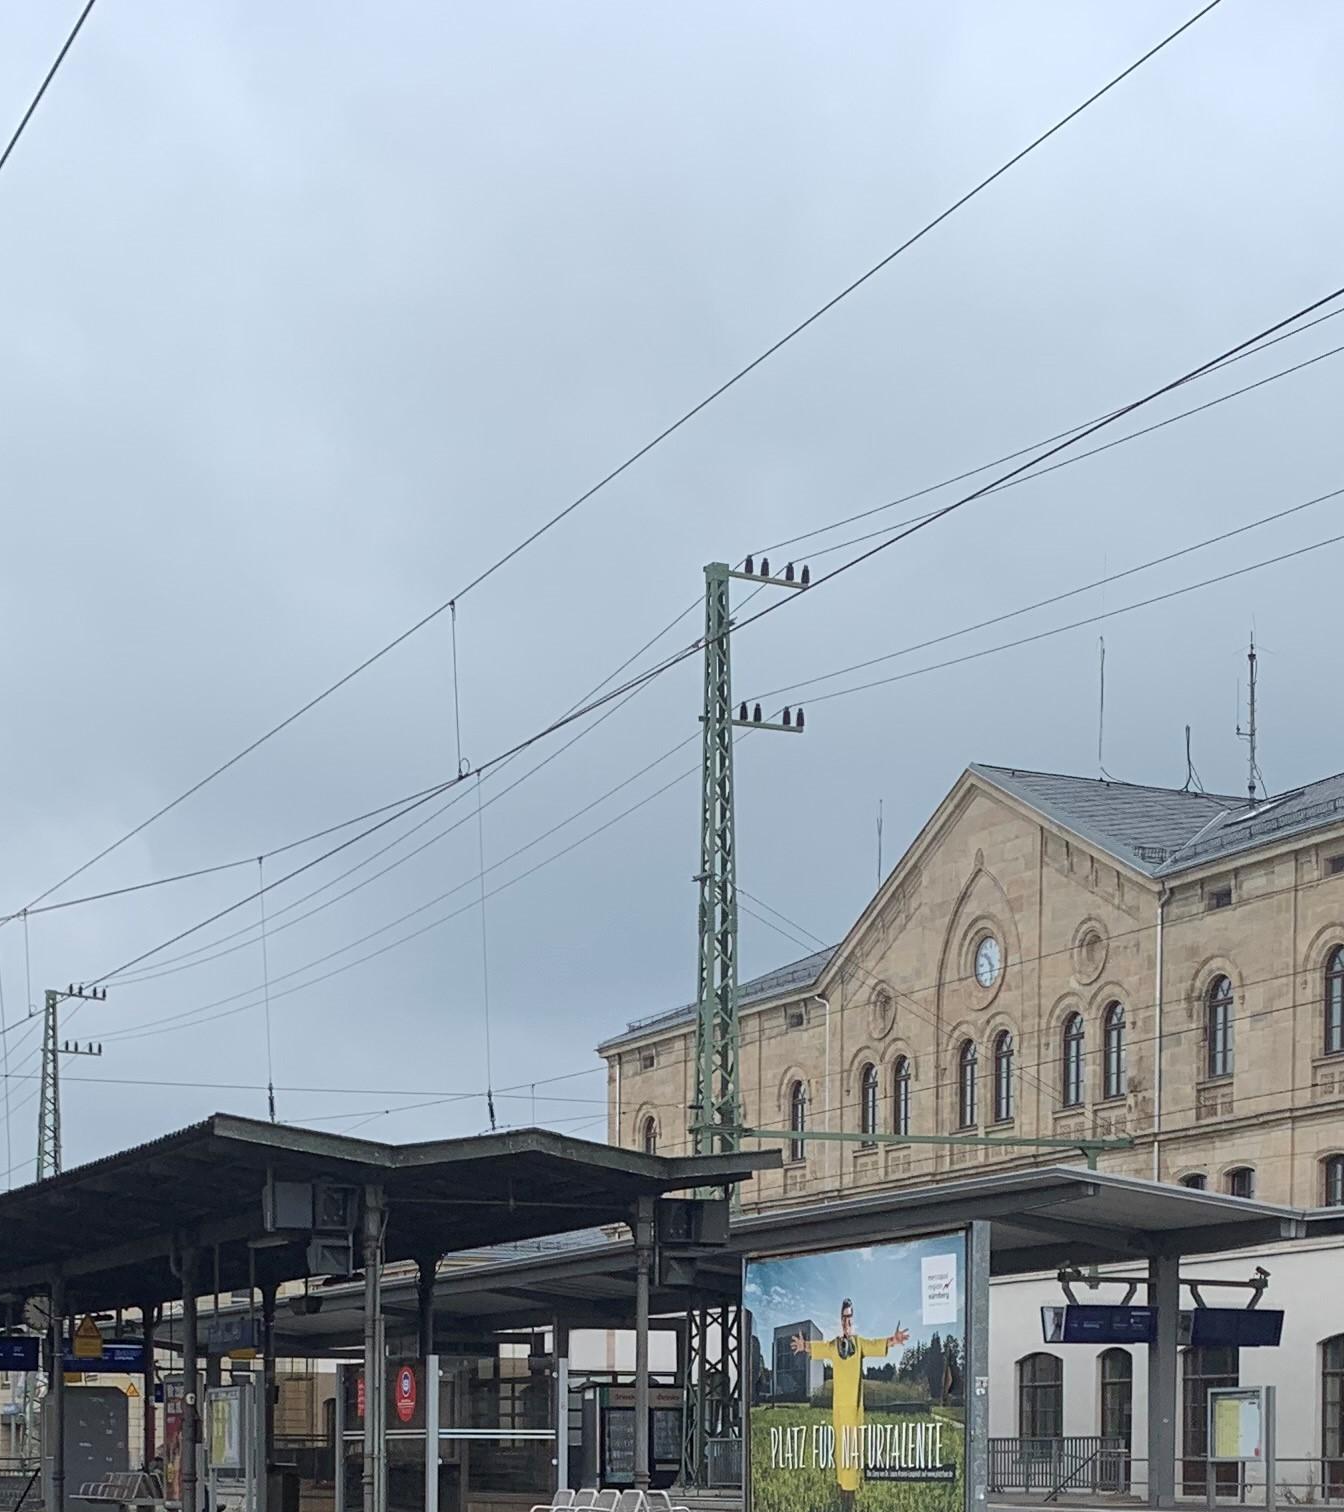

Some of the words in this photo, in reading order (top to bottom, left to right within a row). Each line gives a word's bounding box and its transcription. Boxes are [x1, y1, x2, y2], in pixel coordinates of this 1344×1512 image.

[770, 1425, 806, 1469] PLATZ
[812, 1420, 836, 1469] FÜR
[841, 1422, 943, 1469] NATURTALENTE
